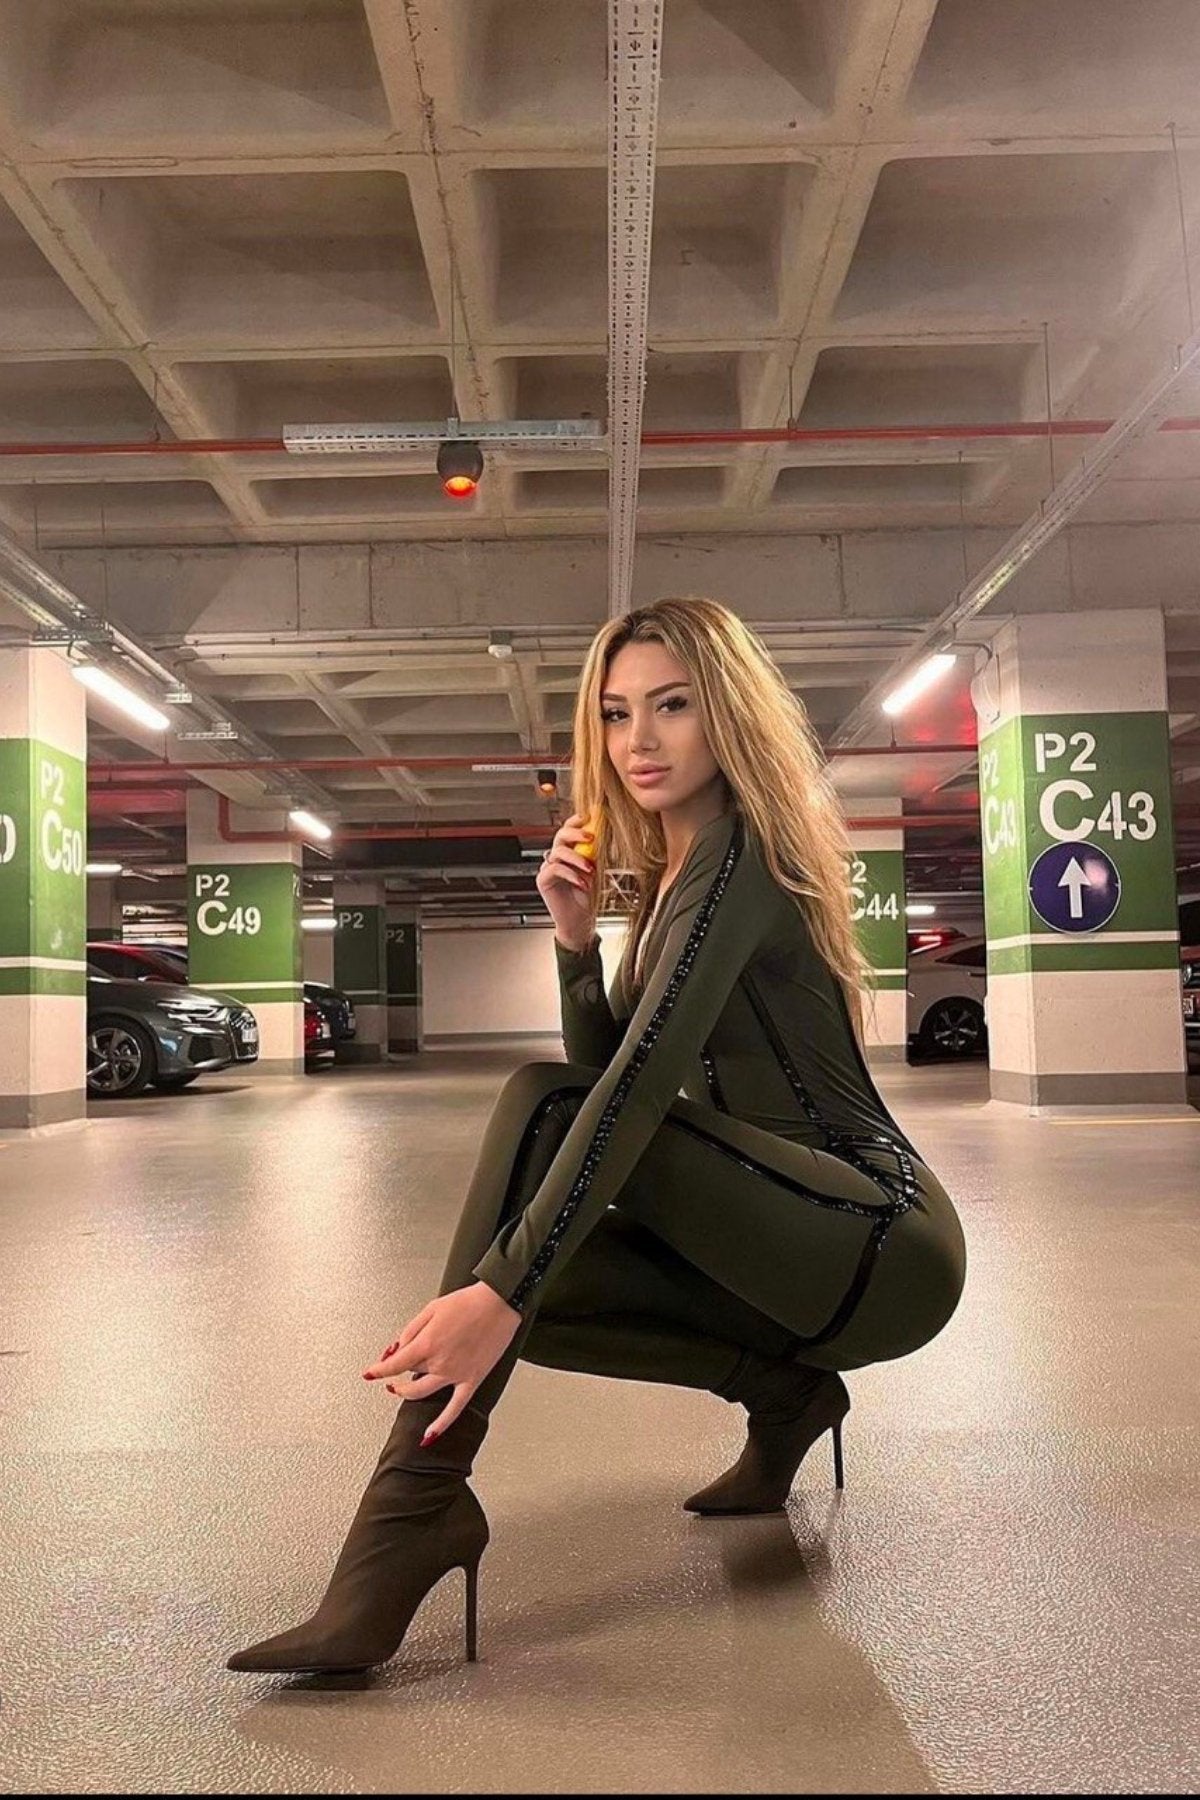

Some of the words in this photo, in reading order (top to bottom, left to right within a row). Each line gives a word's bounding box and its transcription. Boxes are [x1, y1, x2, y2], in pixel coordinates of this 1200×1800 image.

[1035, 732, 1097, 773] P2
[41, 759, 65, 806] P2
[1039, 779, 1157, 841] C43
[42, 809, 83, 876] C50
[195, 873, 231, 897] P2
[196, 900, 262, 936] C49
[339, 912, 364, 929] P2
[386, 929, 405, 943] P2
